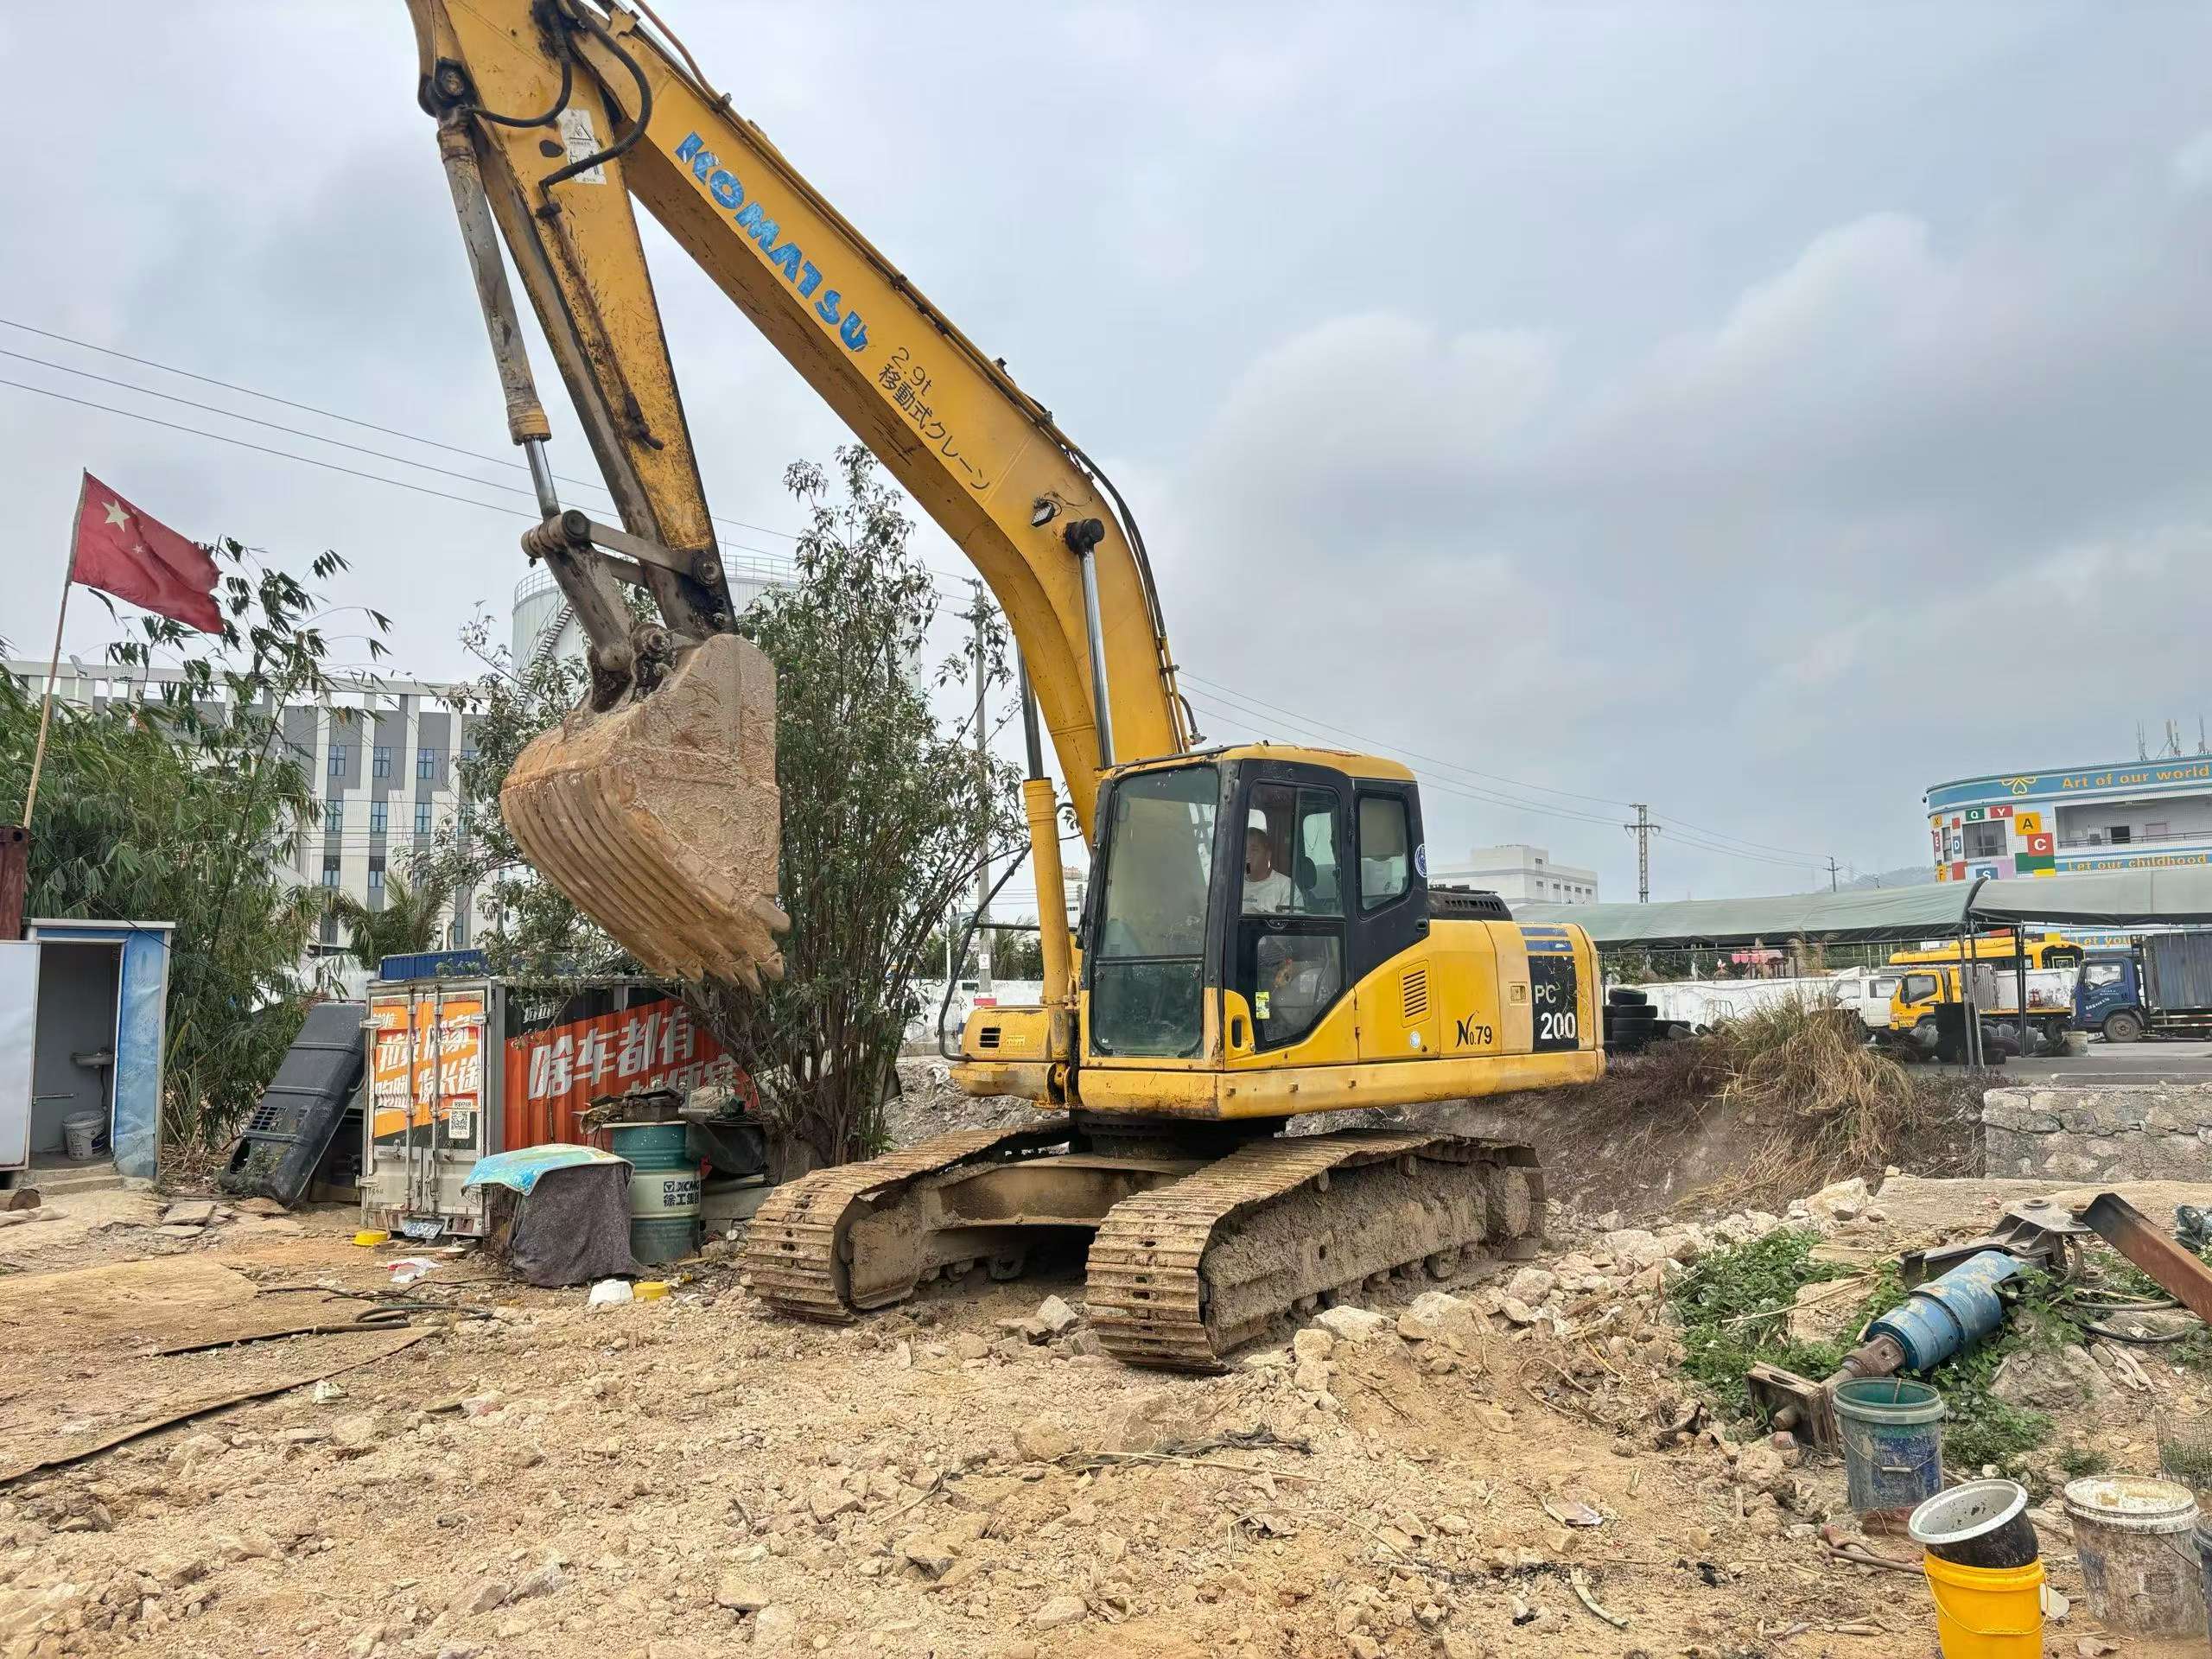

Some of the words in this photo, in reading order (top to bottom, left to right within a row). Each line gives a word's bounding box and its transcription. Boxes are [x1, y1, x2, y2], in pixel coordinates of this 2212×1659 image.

[674, 131, 870, 353] KOMATSU
[891, 346, 932, 397] 2.9t
[879, 364, 990, 490] 移動式クレーン
[2062, 776, 2088, 788] Art
[2096, 773, 2113, 785] of
[2120, 772, 2149, 784] our
[2157, 765, 2209, 780] world
[1997, 808, 2005, 817] Y
[2022, 817, 2034, 830] A
[1954, 840, 1960, 850] D
[2033, 838, 2047, 850] C
[1534, 984, 1556, 1004] PC
[1455, 1009, 1492, 1049] No.79
[1541, 1012, 1576, 1040] 200
[528, 1006, 695, 1101] 啥车都有
